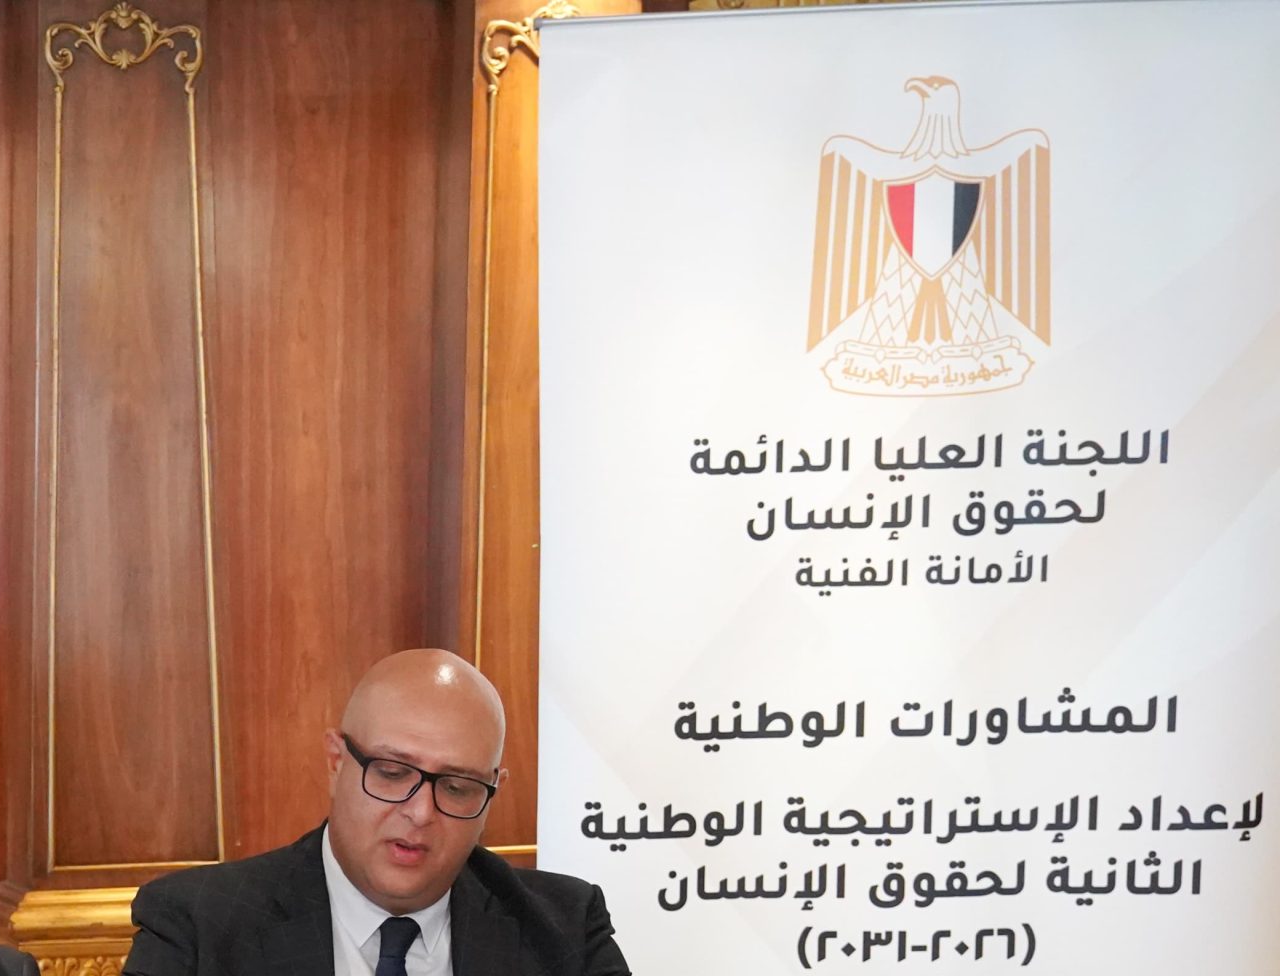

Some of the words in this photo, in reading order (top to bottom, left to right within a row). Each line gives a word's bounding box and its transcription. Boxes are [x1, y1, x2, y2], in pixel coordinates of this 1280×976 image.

[690, 434, 850, 476] الدائمة
[874, 433, 1003, 482] العليا
[1022, 429, 1169, 477] اللجنة
[746, 493, 930, 541] الإنسان
[952, 489, 1106, 537] لحقوق
[795, 557, 908, 597] الفنية
[925, 550, 1048, 585] الأمانة
[674, 700, 865, 753] الوطنية
[890, 687, 1178, 747] المشاورات
[580, 800, 763, 852] الوطنية
[783, 795, 1099, 847] الإستراتيجية
[1118, 791, 1264, 842] لإعداد
[657, 861, 846, 912] الإنسان
[868, 860, 1026, 909] لحقوق
[1046, 850, 1202, 906] الثانية
